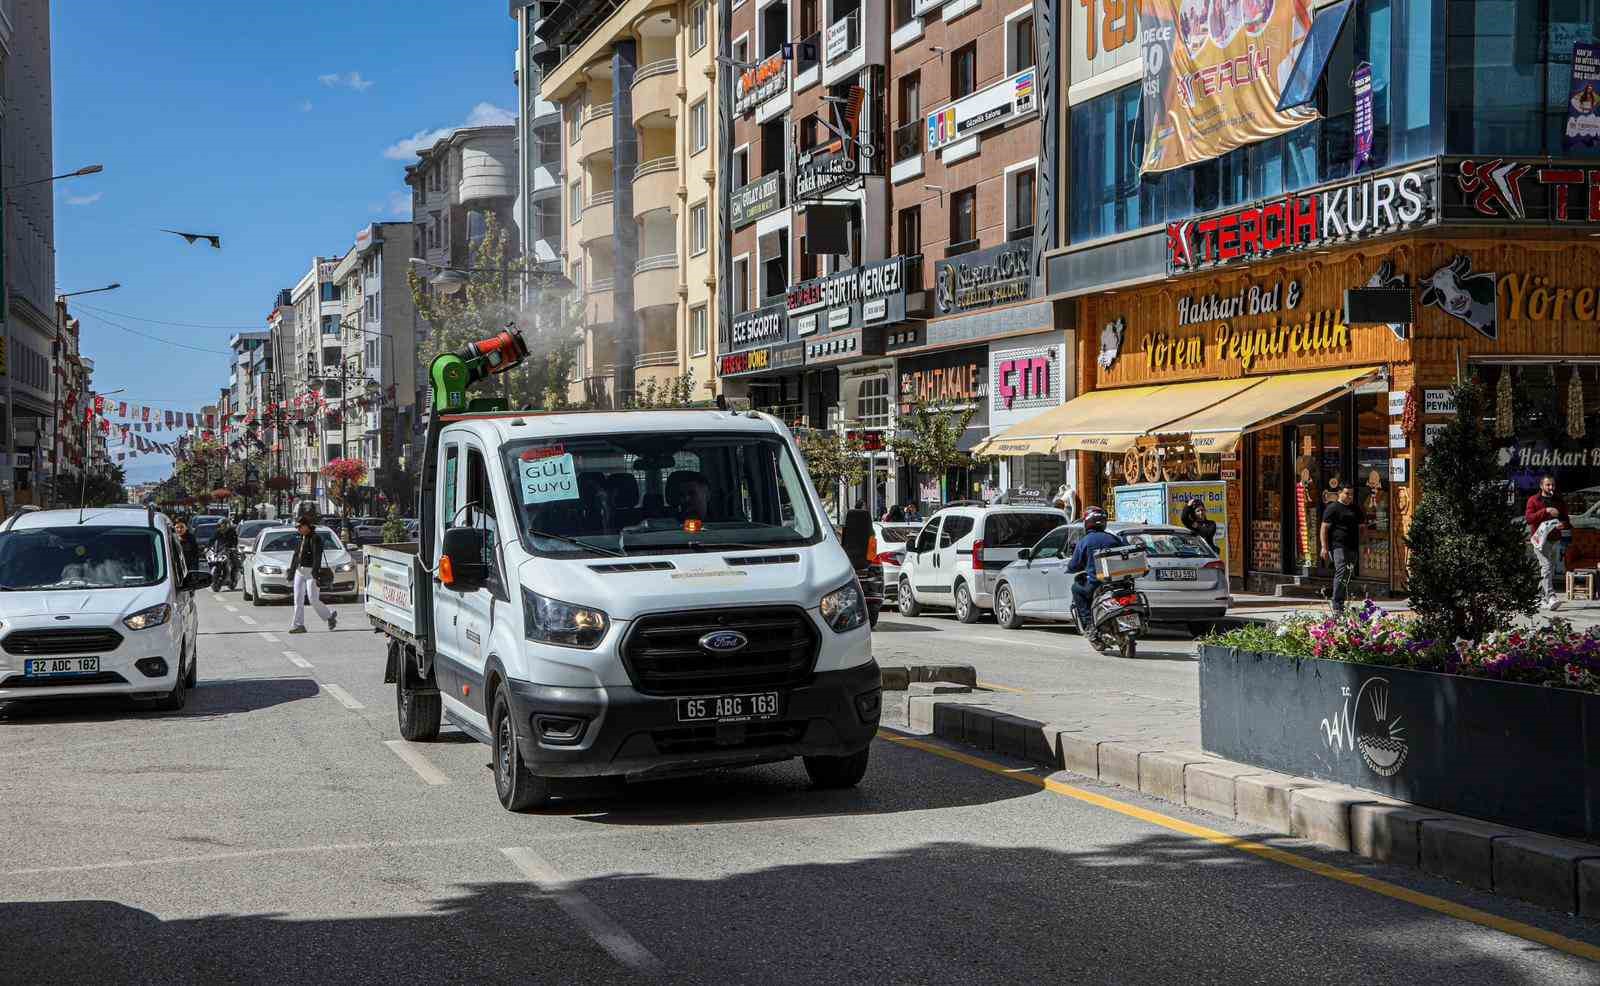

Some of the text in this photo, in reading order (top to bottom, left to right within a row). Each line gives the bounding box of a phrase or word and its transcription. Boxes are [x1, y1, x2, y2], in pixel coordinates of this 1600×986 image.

[1198, 173, 1423, 263] TERCİH KURS
[1178, 280, 1300, 326] Hakkari Bal &
[1497, 272, 1600, 322] Yöre
[733, 321, 746, 342] ECE
[746, 313, 779, 339] SİGORTA
[1141, 307, 1347, 369] Yörem Peynircilik
[912, 363, 977, 402] TAHTAKALE
[1518, 447, 1588, 467] Hakkari
[526, 461, 571, 479] GÜL
[527, 481, 571, 494] SUYU
[714, 638, 738, 649] Ford
[33, 658, 97, 672] 32 ADC 182
[687, 700, 707, 717] 65
[750, 695, 776, 713] 163
